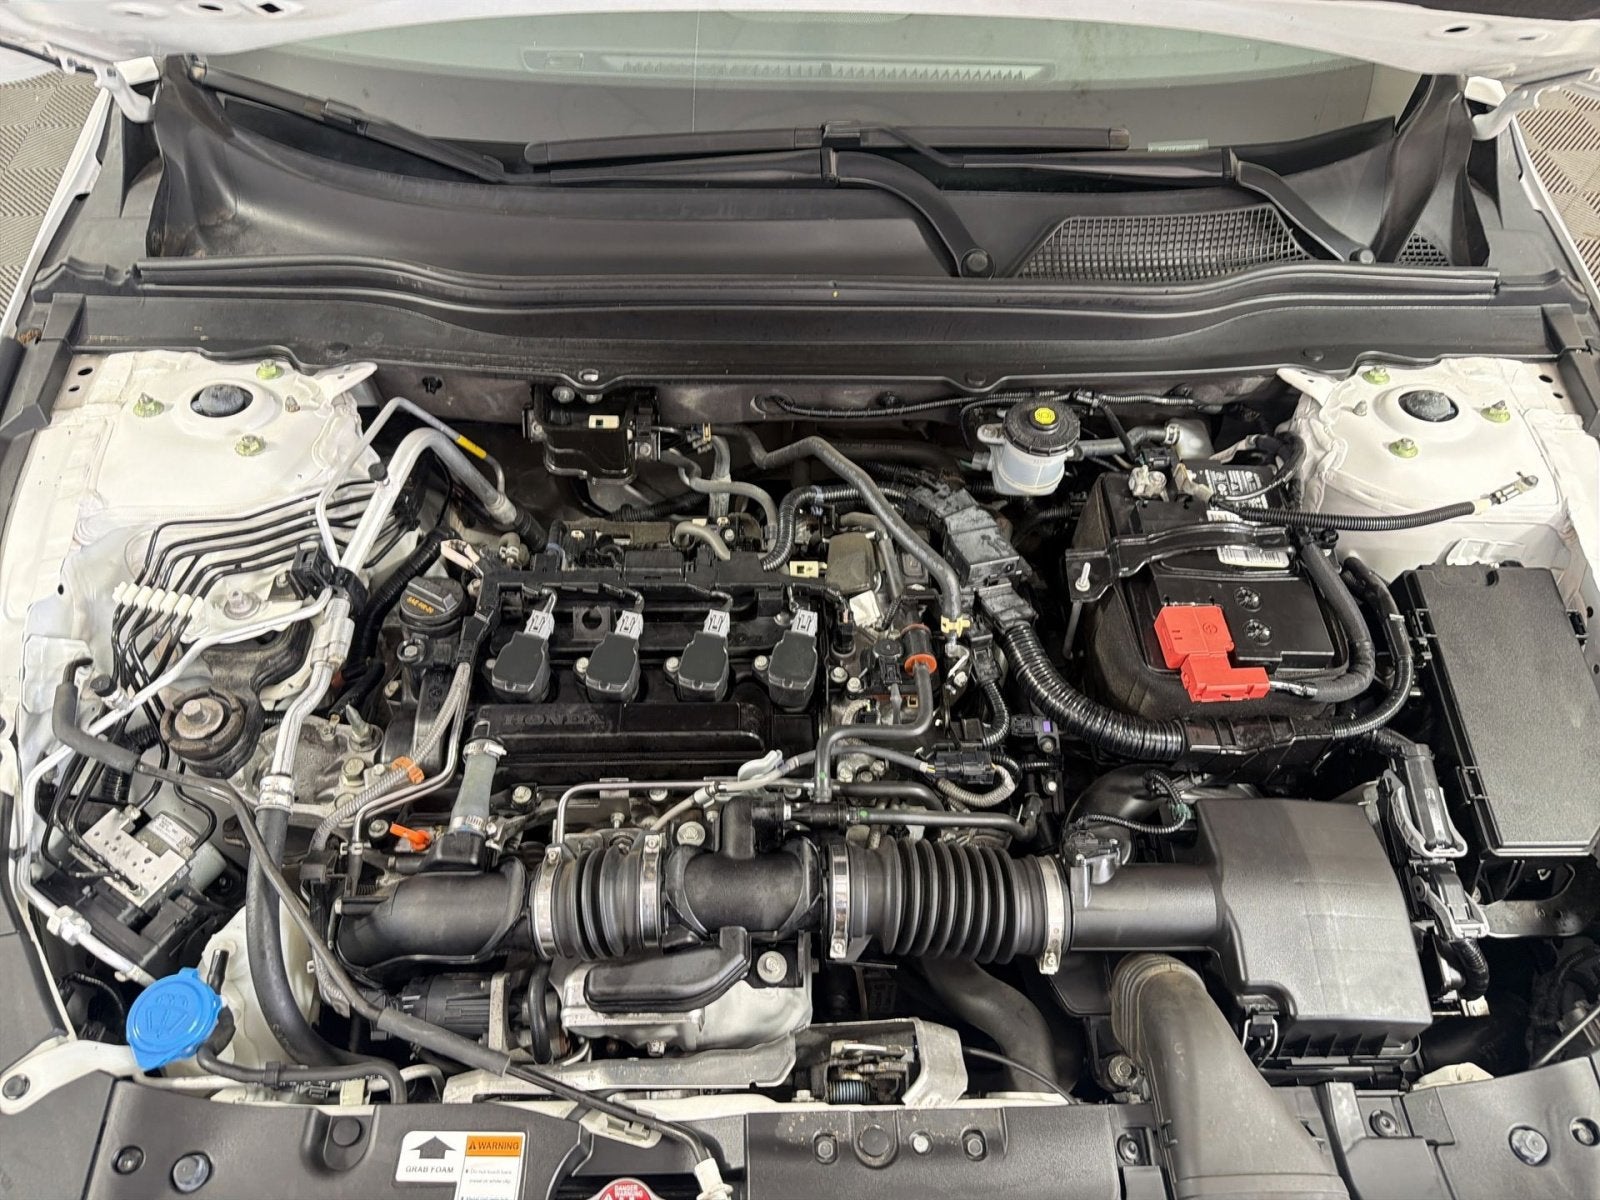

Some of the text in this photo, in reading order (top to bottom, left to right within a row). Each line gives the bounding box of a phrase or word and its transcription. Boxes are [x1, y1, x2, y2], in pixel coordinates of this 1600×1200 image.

[502, 713, 606, 726] HONDA
[477, 1141, 519, 1150] WARNING
[405, 1165, 454, 1173] GRAB FOAM
[614, 1190, 643, 1198] WARNING
